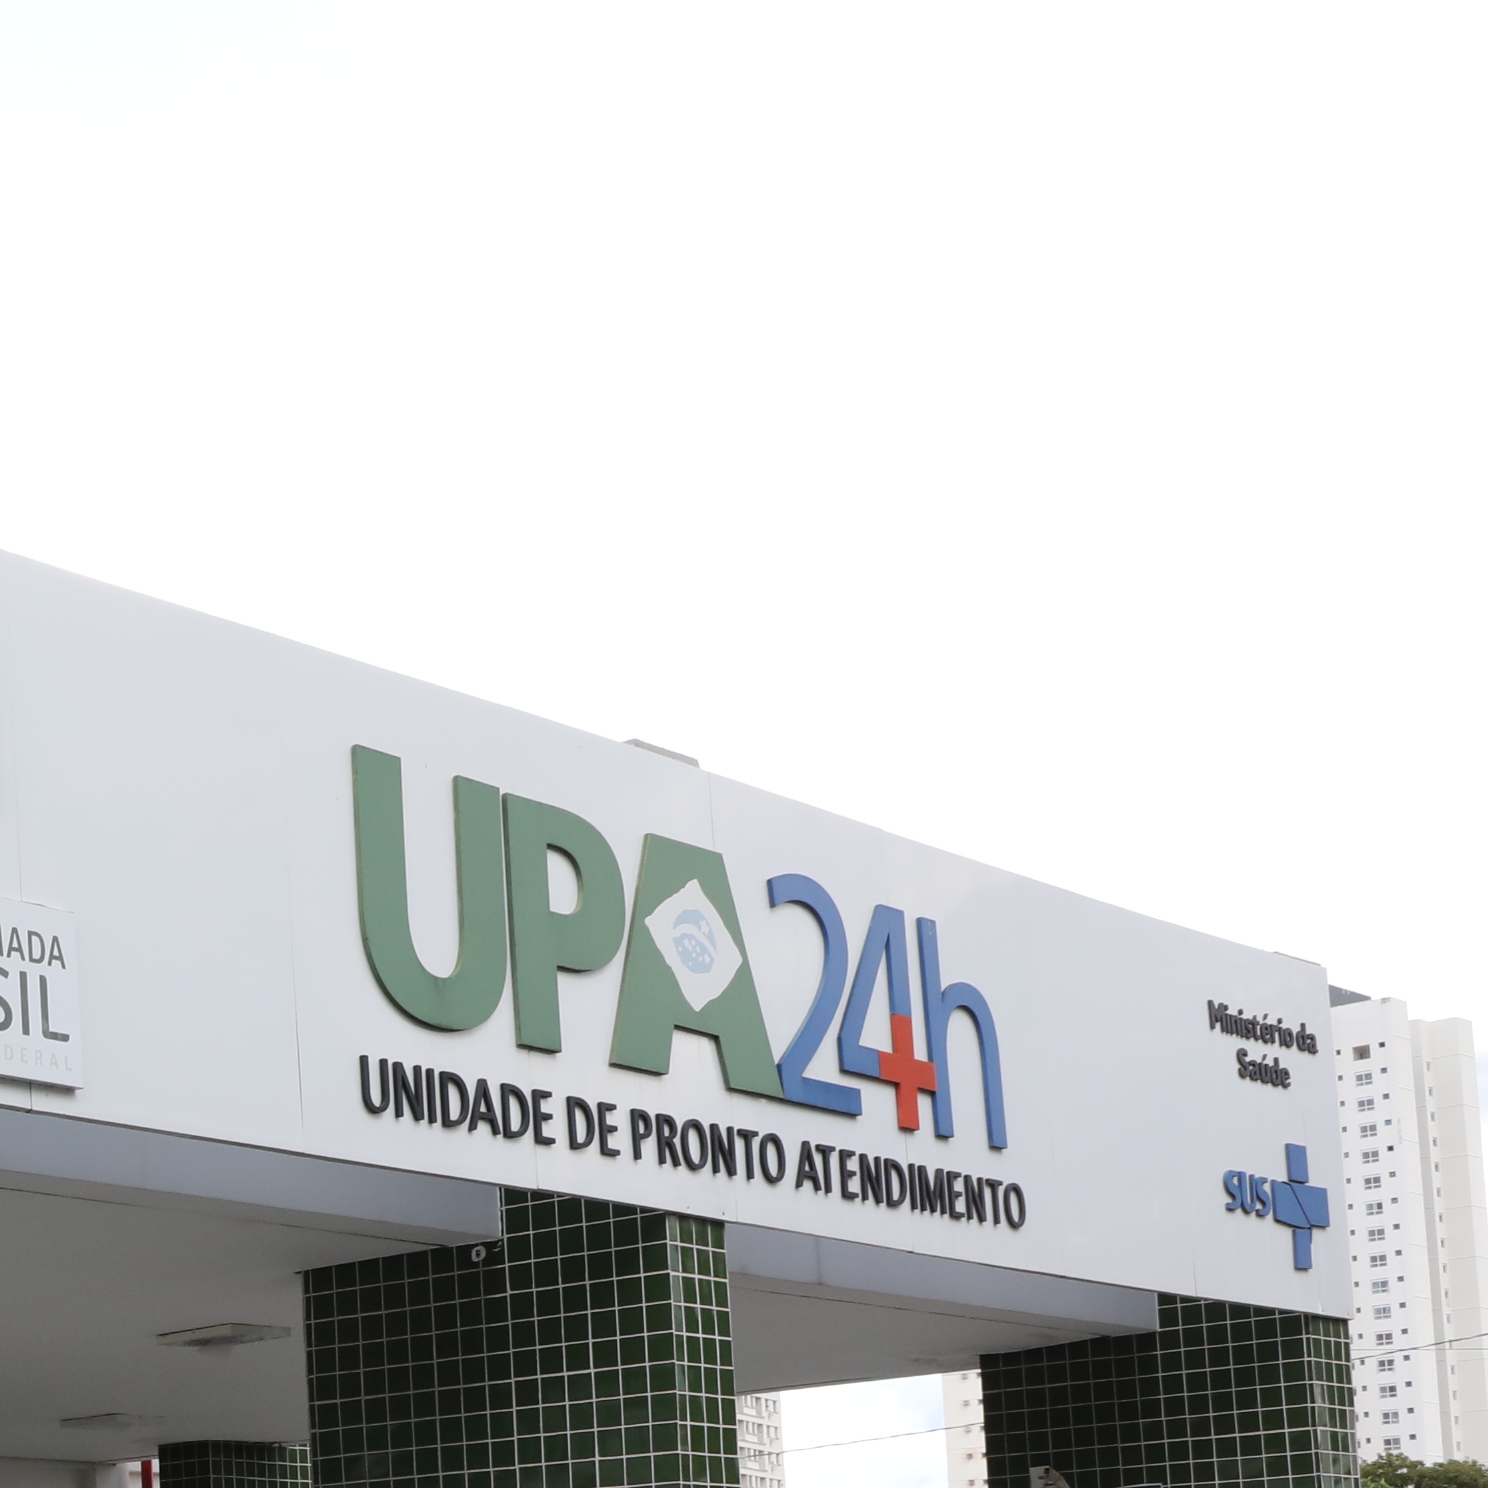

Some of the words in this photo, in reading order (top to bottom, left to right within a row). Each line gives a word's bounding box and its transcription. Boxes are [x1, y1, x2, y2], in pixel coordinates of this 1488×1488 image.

[351, 744, 784, 1099] UPA
[766, 873, 1007, 1149] 24h
[1208, 999, 1295, 1048] Ministério
[1296, 1022, 1319, 1055] da
[1236, 1047, 1292, 1089] Saúde
[358, 1055, 555, 1145] UNIDADE
[566, 1095, 621, 1158] DE
[630, 1108, 787, 1184] PRONTO
[795, 1140, 1027, 1230] ATENDIMENTO
[1223, 1169, 1272, 1217] SUS
